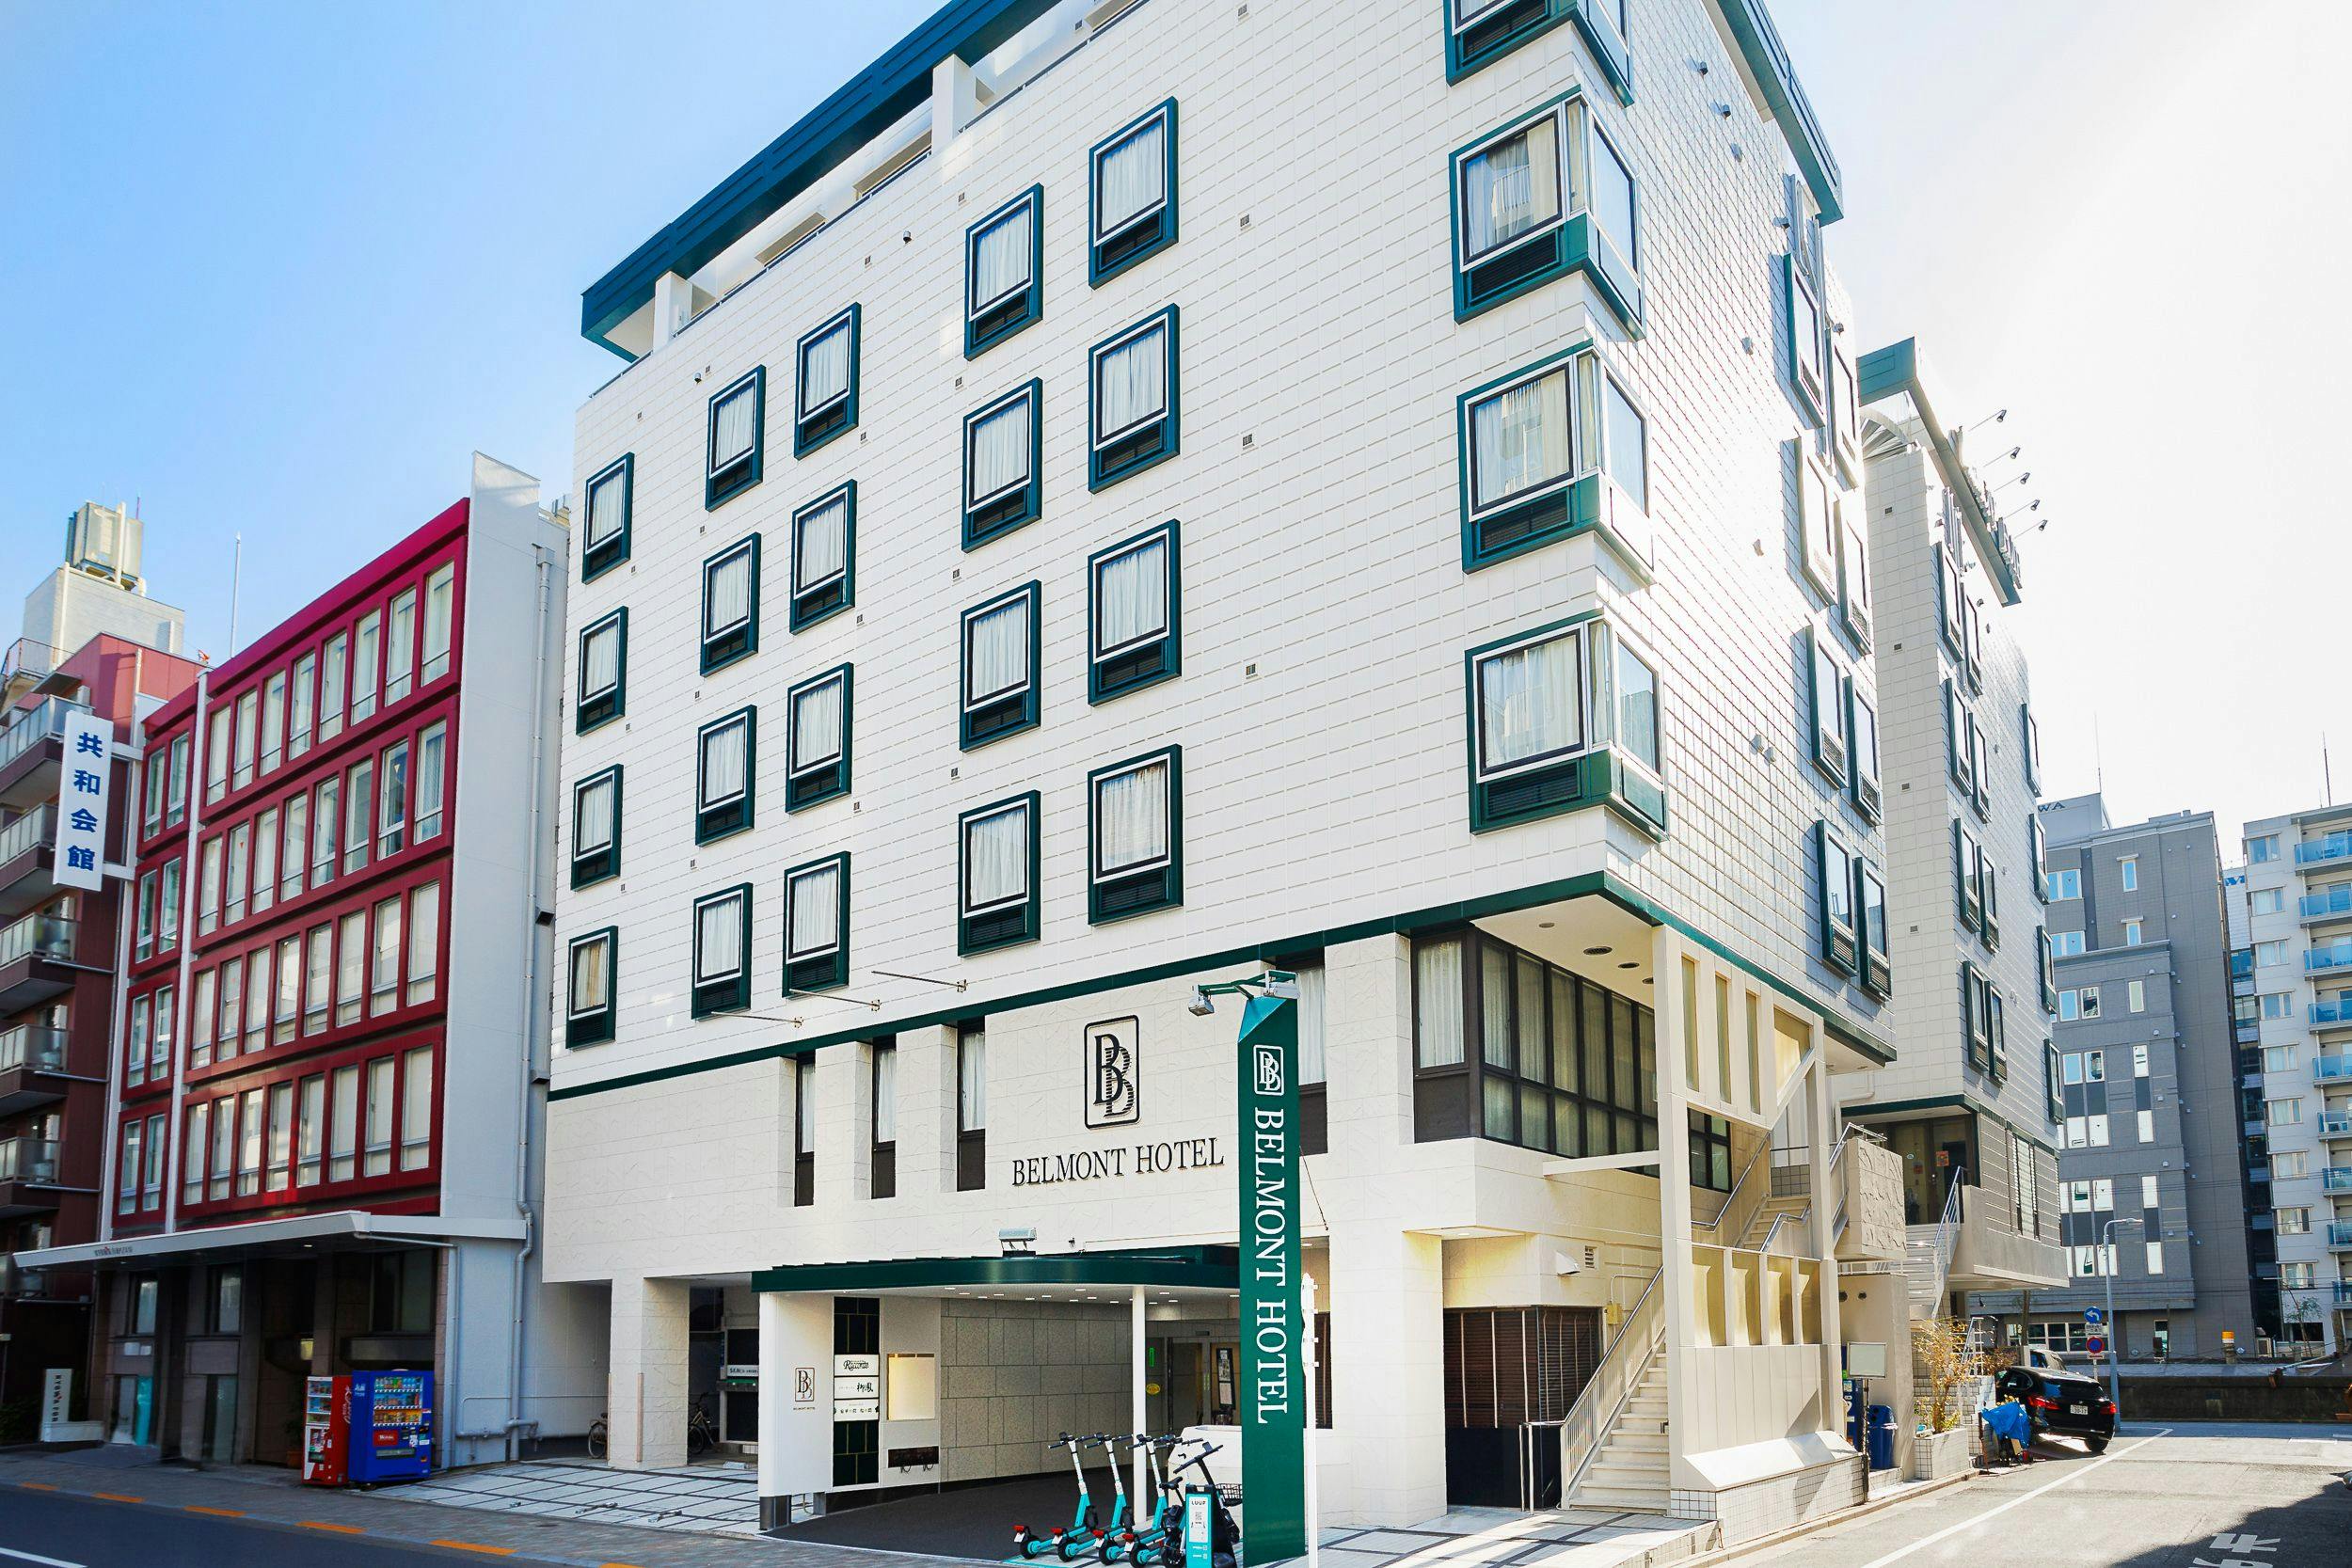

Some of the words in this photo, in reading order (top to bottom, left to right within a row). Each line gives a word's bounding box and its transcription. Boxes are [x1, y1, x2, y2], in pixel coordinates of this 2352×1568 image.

[68, 732, 103, 871] 共和会館
[1012, 1148, 1127, 1186] BELMONT
[1135, 1137, 1225, 1175] HOTEL
[1254, 1108, 1287, 1287] BELMONT
[1256, 1298, 1288, 1424] HOTEL
